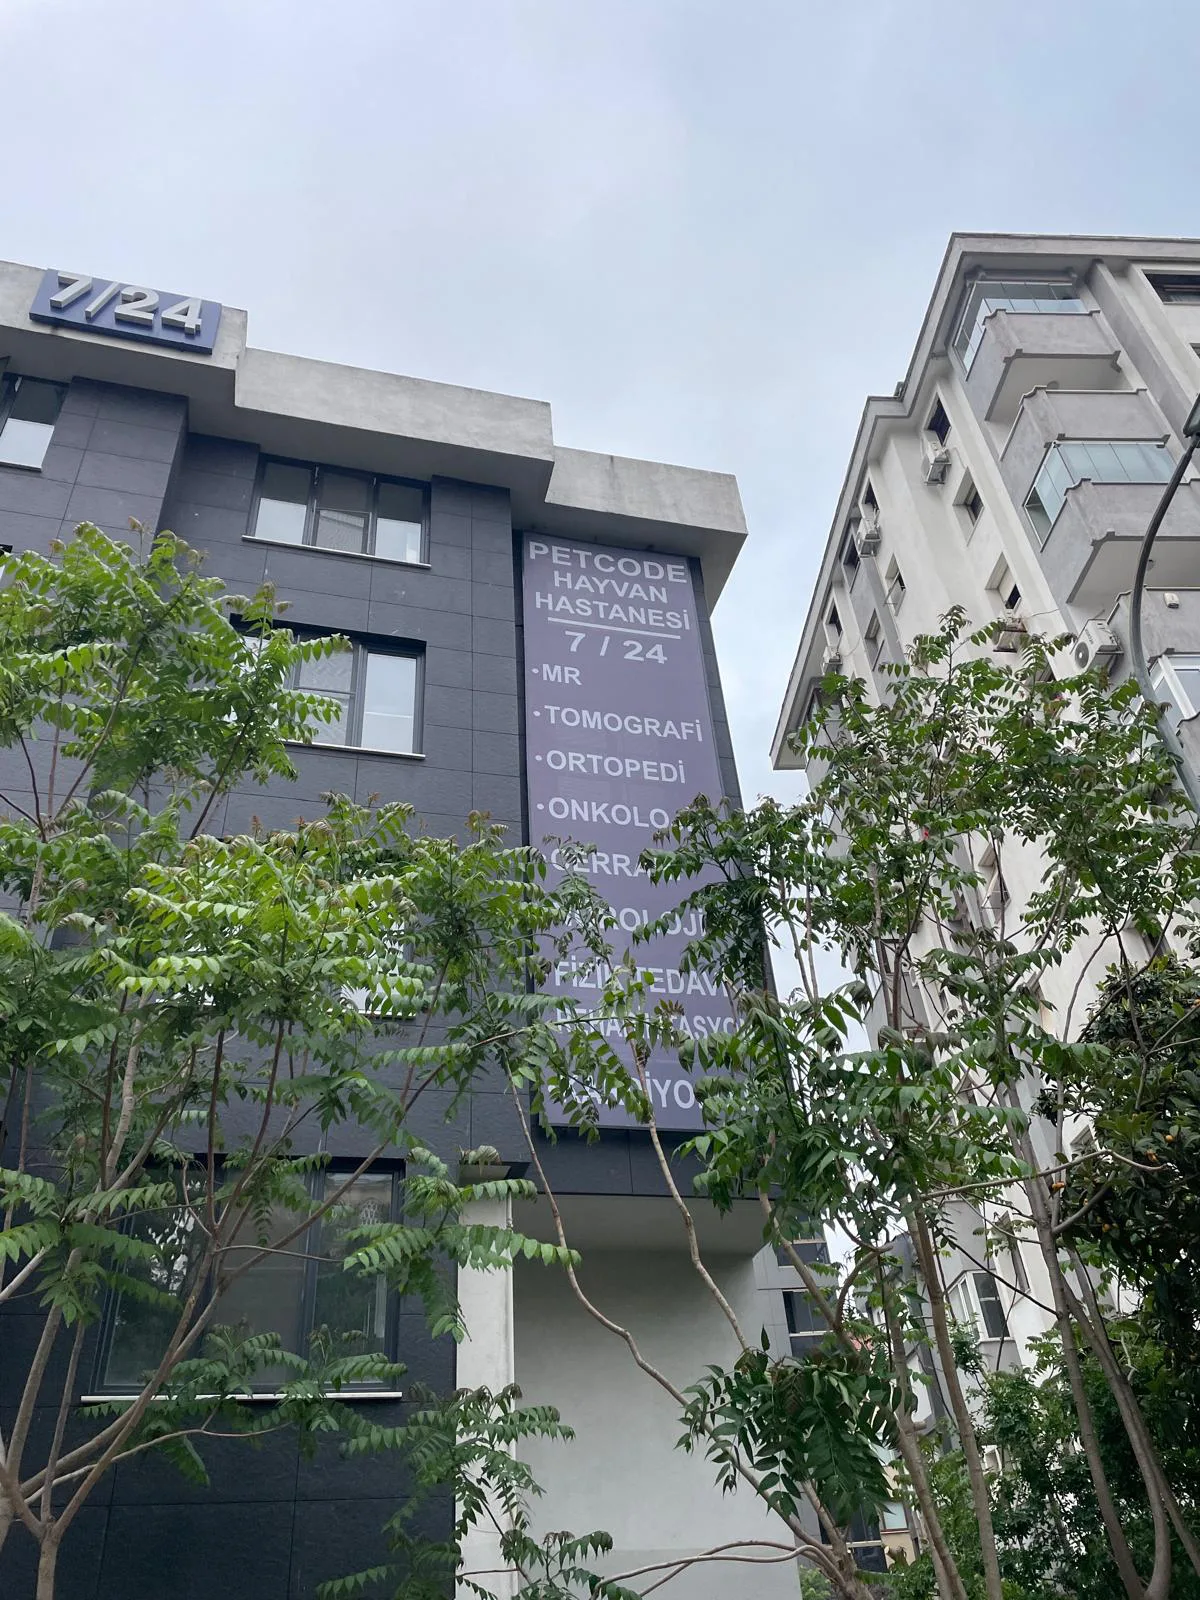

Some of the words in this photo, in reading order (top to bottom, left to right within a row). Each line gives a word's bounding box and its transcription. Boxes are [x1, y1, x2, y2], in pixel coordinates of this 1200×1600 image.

[50, 271, 202, 336] 7/24
[529, 541, 688, 584] PETCODE
[553, 571, 668, 604] HAYVAN
[535, 591, 690, 630] HASTANESİ
[623, 640, 668, 665] 24
[542, 663, 582, 686] MR
[544, 704, 703, 742] TOMOGRAFİ
[546, 749, 686, 784] ORTOPEDİ
[548, 796, 693, 834] ONKOLO
